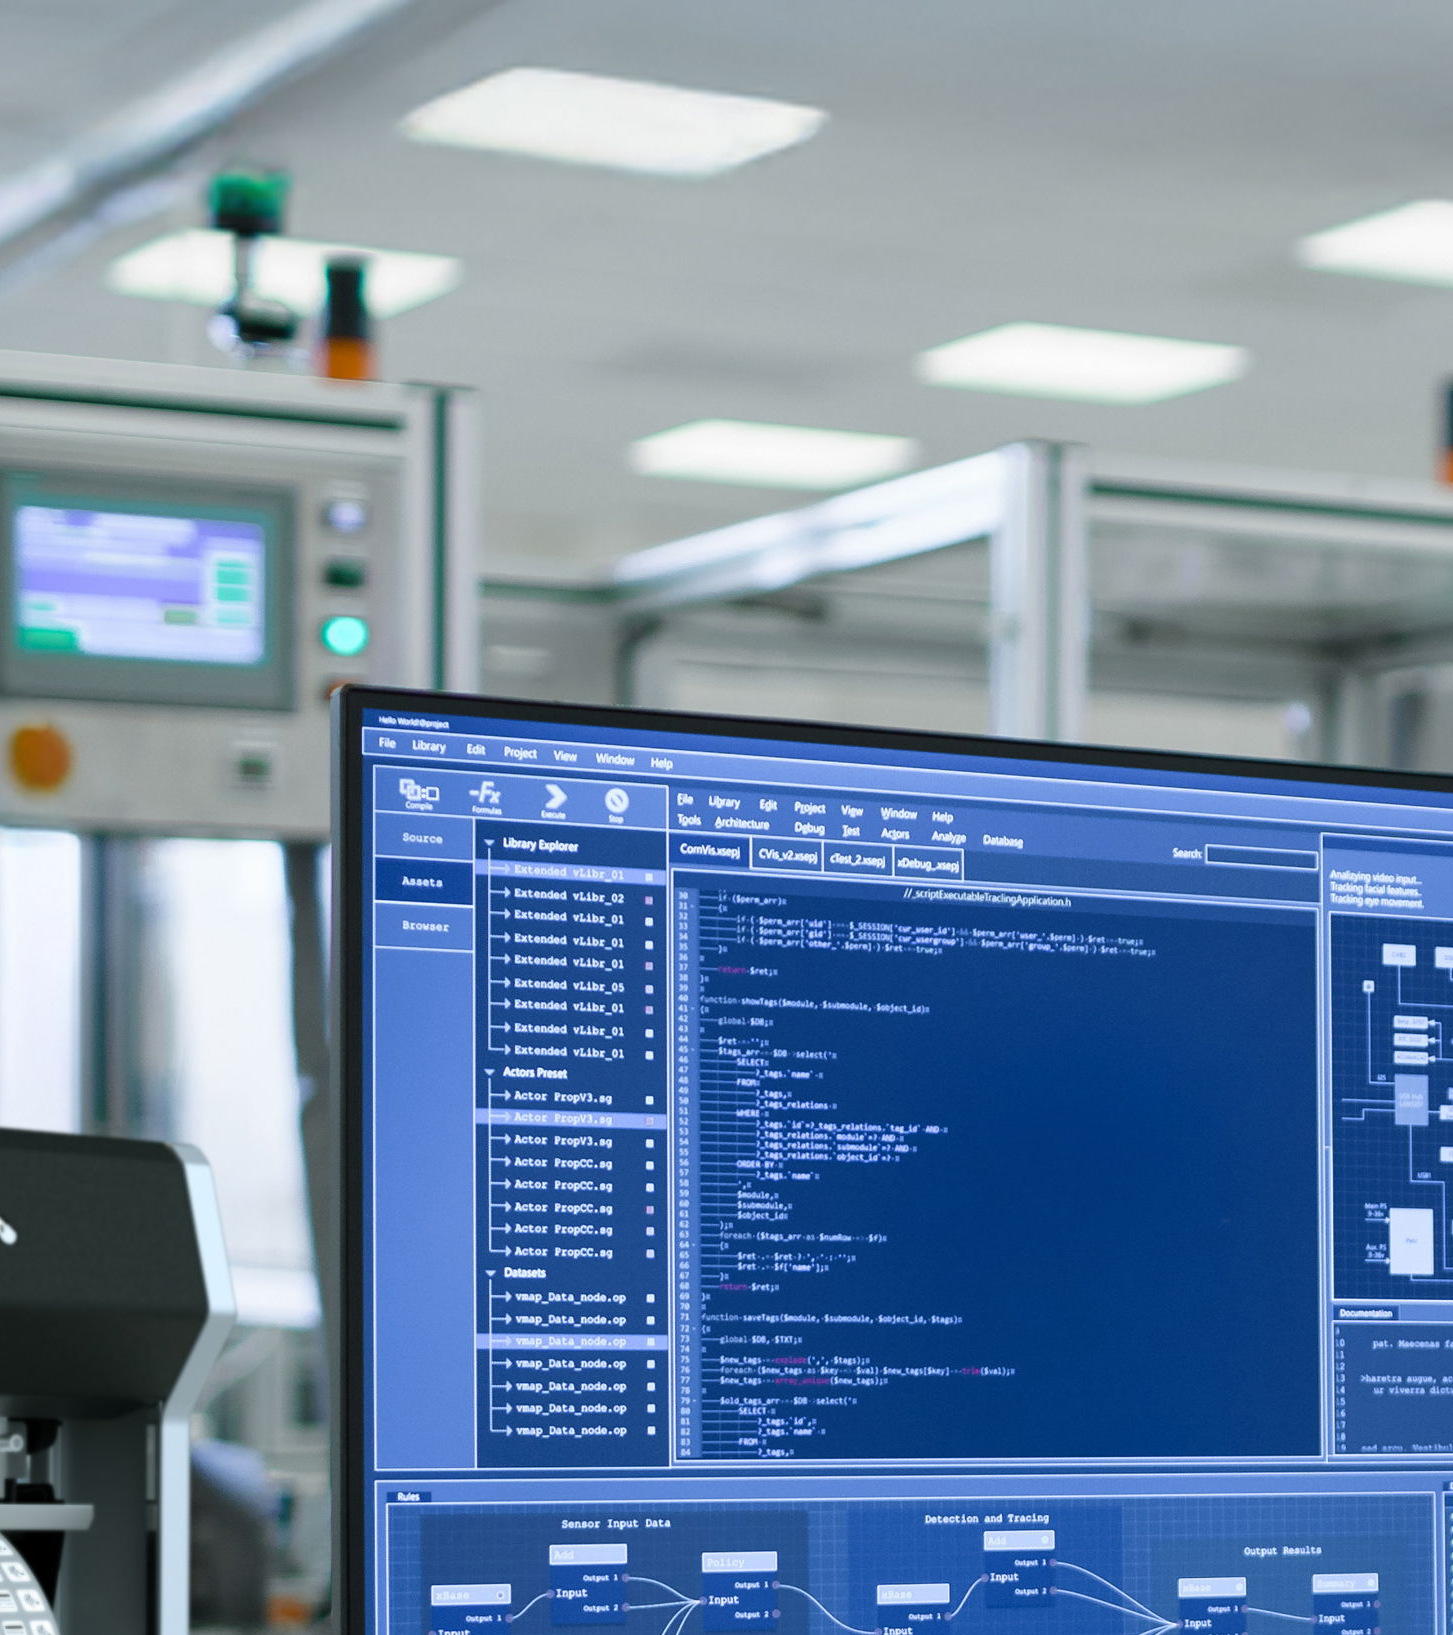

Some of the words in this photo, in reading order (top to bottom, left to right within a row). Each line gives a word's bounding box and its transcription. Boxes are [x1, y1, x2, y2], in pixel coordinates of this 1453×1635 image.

[379, 737, 397, 748] File
[412, 740, 447, 754] Library
[467, 744, 486, 756] Edit
[504, 746, 537, 760] Project
[553, 750, 577, 762] View
[596, 753, 635, 766] Window
[651, 758, 673, 770] Help
[677, 793, 694, 806] File
[708, 796, 740, 810] Library
[759, 799, 778, 811] Edit
[795, 802, 826, 815] Project
[842, 805, 864, 817] View
[881, 807, 918, 821] Window
[932, 811, 954, 824] Help
[541, 810, 566, 819] Execute
[609, 815, 624, 824] Stop
[403, 832, 443, 844] Source
[678, 814, 701, 826] Tools
[715, 817, 770, 831] Architecture
[795, 822, 825, 836] Debug
[843, 825, 860, 836] Test
[881, 827, 910, 840] Actors
[932, 831, 967, 844] Analyze
[983, 835, 1023, 849] Database
[503, 838, 536, 852] Library
[539, 840, 579, 852] Explorer
[1173, 848, 1203, 858] Search:
[515, 865, 567, 877] Extended
[573, 868, 624, 881] vLibr_01
[1373, 873, 1394, 882] video
[402, 876, 443, 888] Assets
[1330, 882, 1363, 895] Tracking
[1365, 884, 1386, 894] facial
[515, 888, 567, 900] Extended
[573, 891, 624, 906] vLibr_02
[1330, 893, 1363, 907] Tracking
[515, 910, 567, 921] Extended
[573, 912, 624, 926] vLibr_01
[403, 921, 449, 932] Browser
[515, 934, 567, 944] Extended
[573, 936, 624, 949] vLibr_01
[515, 955, 567, 966] Extended
[573, 958, 624, 970] vLibr_01
[515, 978, 567, 990] Extended
[573, 980, 624, 994] vLibr_05
[503, 1068, 535, 1078] Actors
[537, 1068, 567, 1079] Preset
[515, 1091, 547, 1101] Actor
[555, 1092, 612, 1104] PropV3.sg
[515, 1113, 547, 1122] Actor
[514, 1135, 547, 1145] Actor
[554, 1137, 612, 1148] PropV3.sg
[514, 1157, 547, 1167] Actor
[554, 1159, 612, 1171] PropCC.sg
[504, 1267, 546, 1278] Datasets
[1340, 1309, 1392, 1319] Documentation
[397, 1491, 420, 1503] Rules
[561, 1519, 600, 1530] Sensor
[608, 1519, 637, 1531] Input
[643, 1518, 671, 1528] Data
[925, 1514, 979, 1525] Detection
[985, 1514, 1003, 1524] and
[1007, 1513, 1050, 1525] Tracing
[1245, 1545, 1277, 1557] Output
[1283, 1544, 1321, 1556] Results
[990, 1572, 1019, 1583] Input
[556, 1588, 588, 1599] Input
[708, 1595, 739, 1606] Input
[1185, 1618, 1212, 1629] Input
[1319, 1614, 1345, 1624] Input
